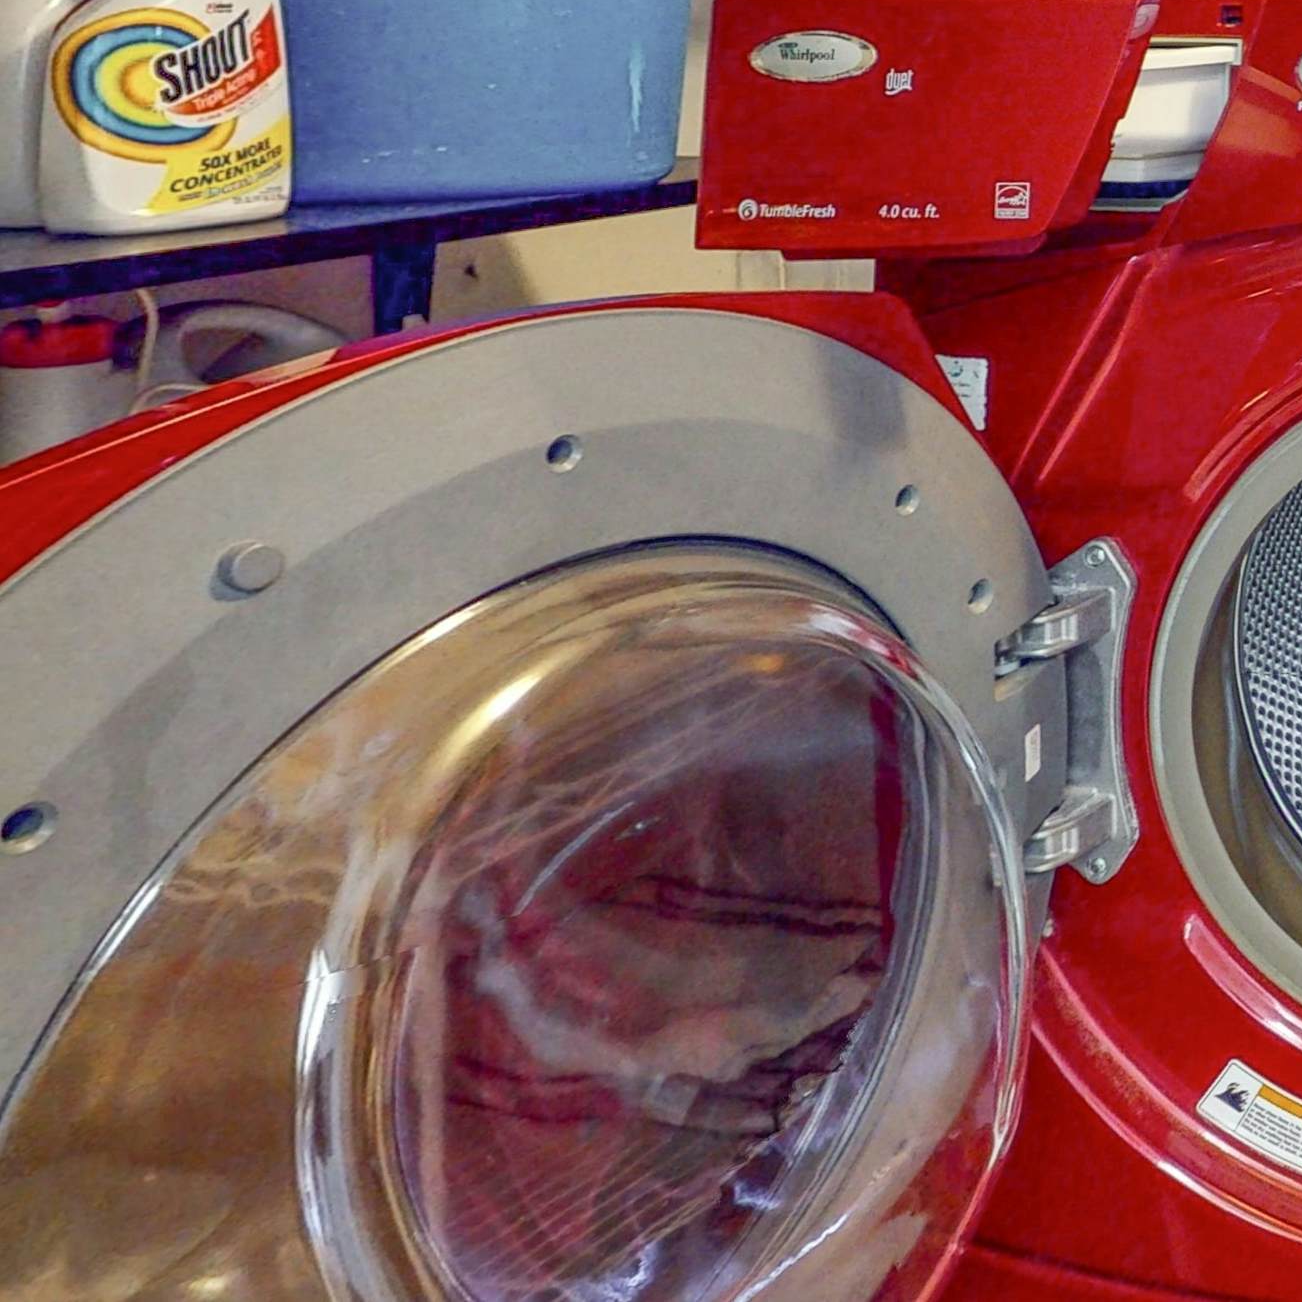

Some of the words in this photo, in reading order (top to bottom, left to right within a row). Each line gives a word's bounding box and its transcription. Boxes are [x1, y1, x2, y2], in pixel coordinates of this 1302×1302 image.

[154, 8, 250, 103] SHOUT
[780, 48, 836, 64] Whirlpool
[884, 68, 913, 95] duet
[235, 137, 271, 161] MORE
[169, 144, 283, 193] CONCENTRATED
[759, 202, 836, 219] TumbleFresh
[878, 203, 899, 219] 4.0
[901, 206, 921, 219] cu.
[924, 202, 940, 219] ft.
